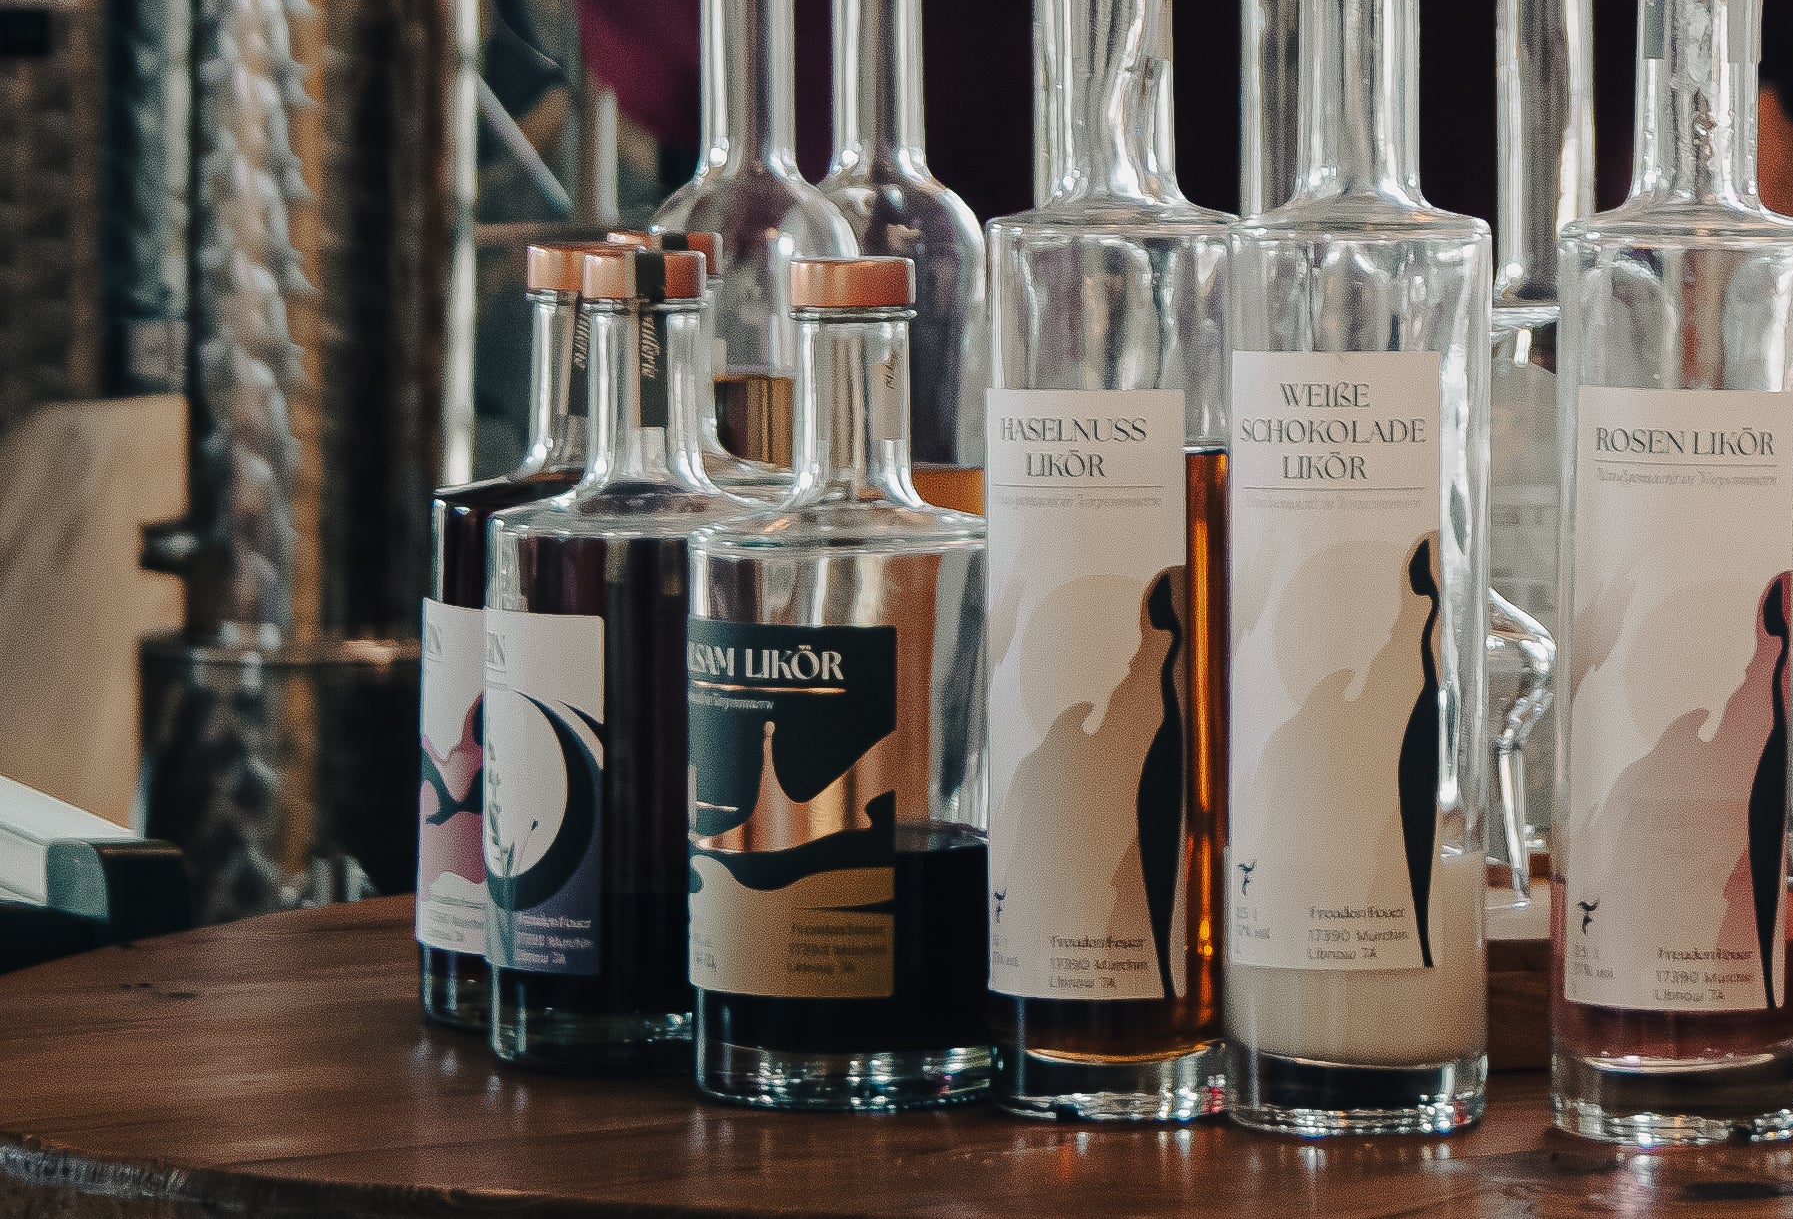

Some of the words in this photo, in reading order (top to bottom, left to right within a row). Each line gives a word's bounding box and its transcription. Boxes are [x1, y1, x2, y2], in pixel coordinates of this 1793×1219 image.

[1000, 417, 1147, 442] HASELNUSS
[1240, 418, 1426, 443] SCHOKOLADE
[1596, 427, 1684, 454] ROSEN
[1693, 427, 1774, 455] LIKÖR
[1026, 449, 1106, 477] LIKÖR
[1283, 452, 1367, 480] LIKÖR
[745, 645, 844, 680] LIKÖR
